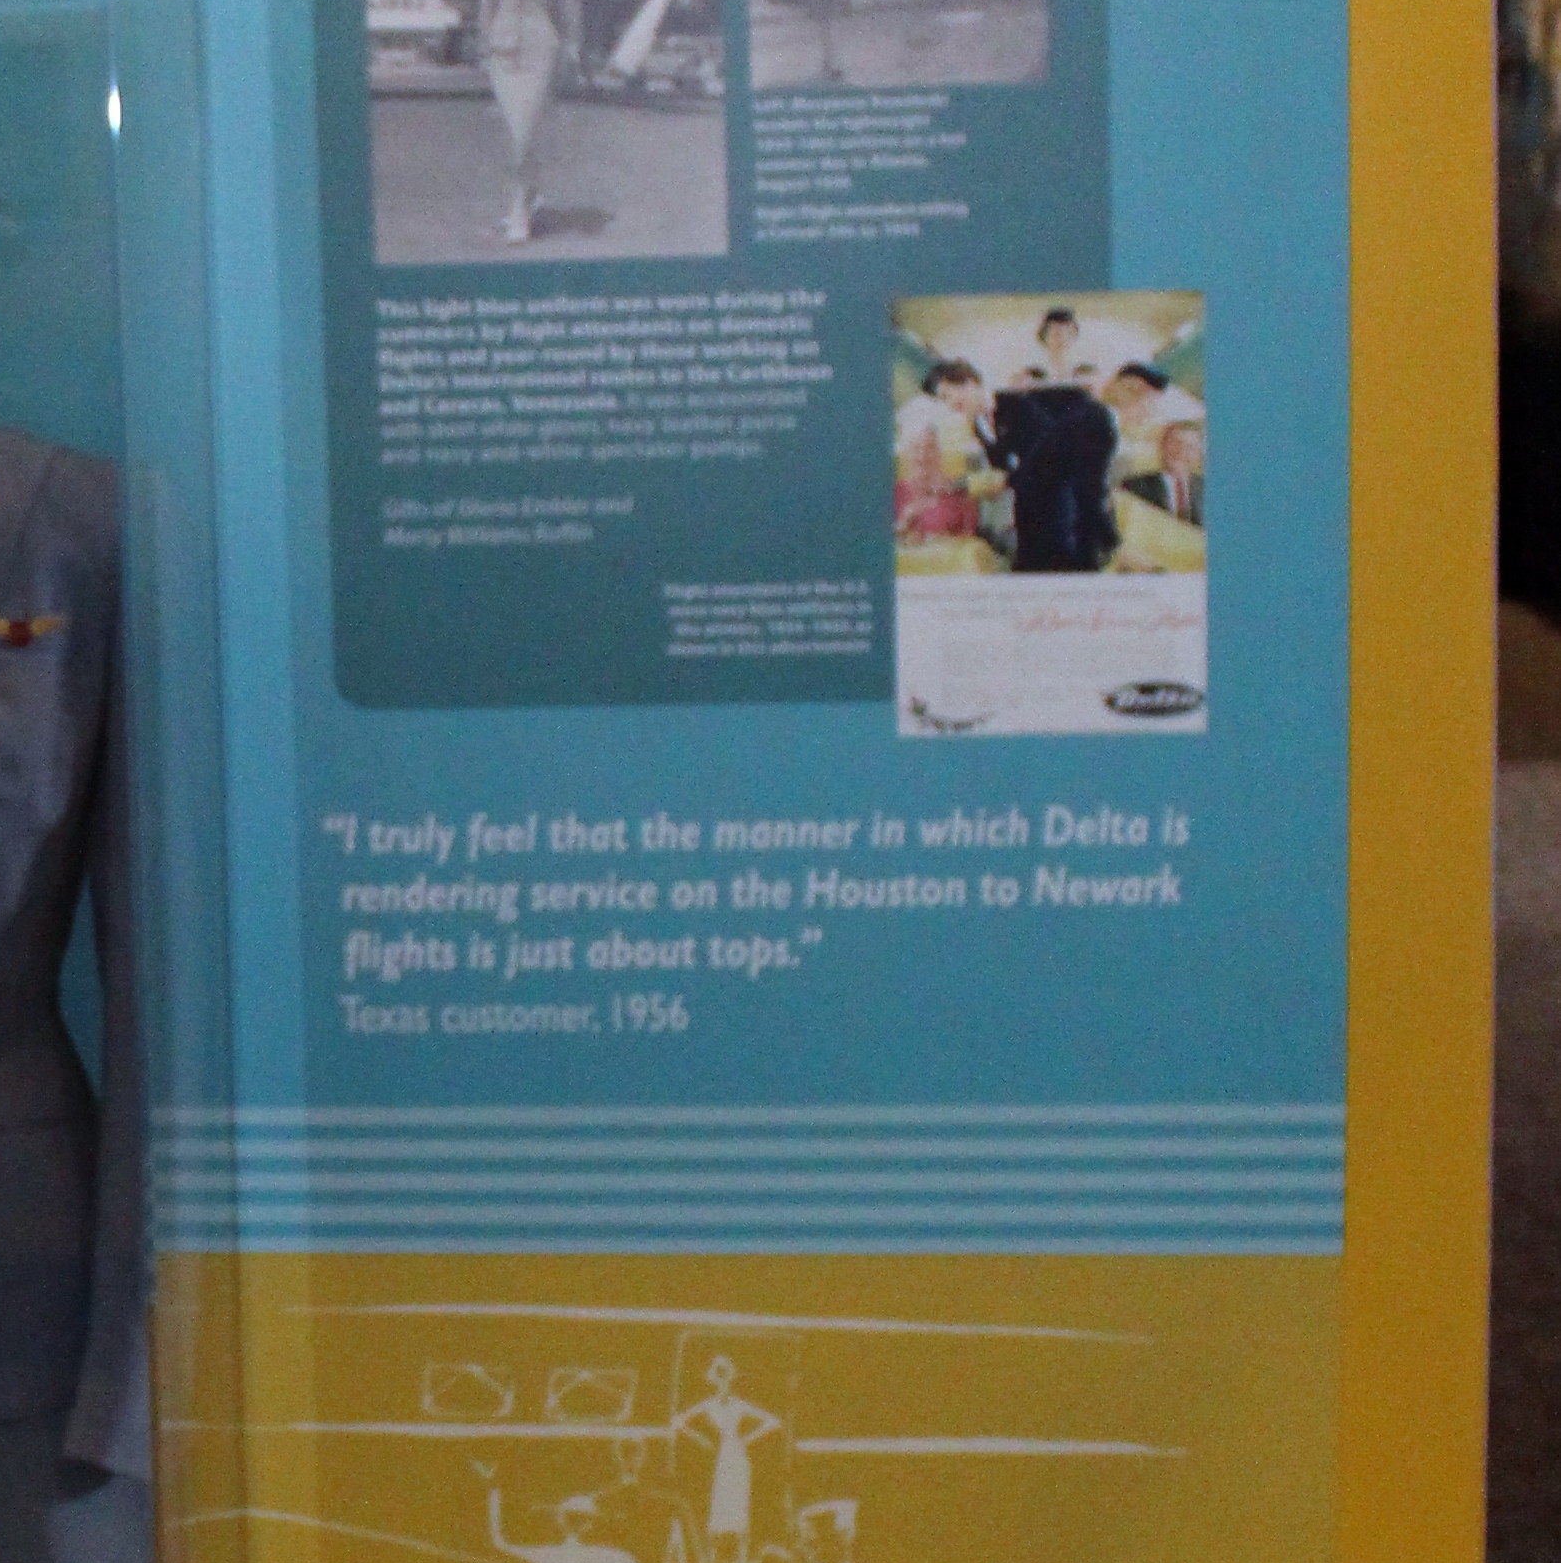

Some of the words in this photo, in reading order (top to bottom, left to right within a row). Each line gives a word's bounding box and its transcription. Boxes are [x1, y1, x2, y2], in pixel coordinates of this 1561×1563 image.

[369, 814, 455, 864] truly
[466, 812, 538, 864] feel
[550, 812, 627, 853] that
[643, 811, 701, 853] the
[714, 820, 861, 852] manner
[870, 809, 906, 850] in
[919, 808, 1030, 850] which
[1042, 805, 1149, 849] Delta
[1162, 805, 1190, 848] is
[342, 872, 518, 922] rendering
[530, 872, 657, 911] service
[671, 878, 718, 910] on
[730, 871, 791, 910] the
[806, 868, 966, 909] Houston
[980, 871, 1020, 907] to
[1035, 864, 1180, 908] Newark
[345, 930, 456, 983] flights
[468, 930, 496, 974] is
[505, 930, 574, 982] just
[588, 928, 697, 972] about
[339, 994, 430, 1035] Texas
[613, 992, 689, 1033] 1956
